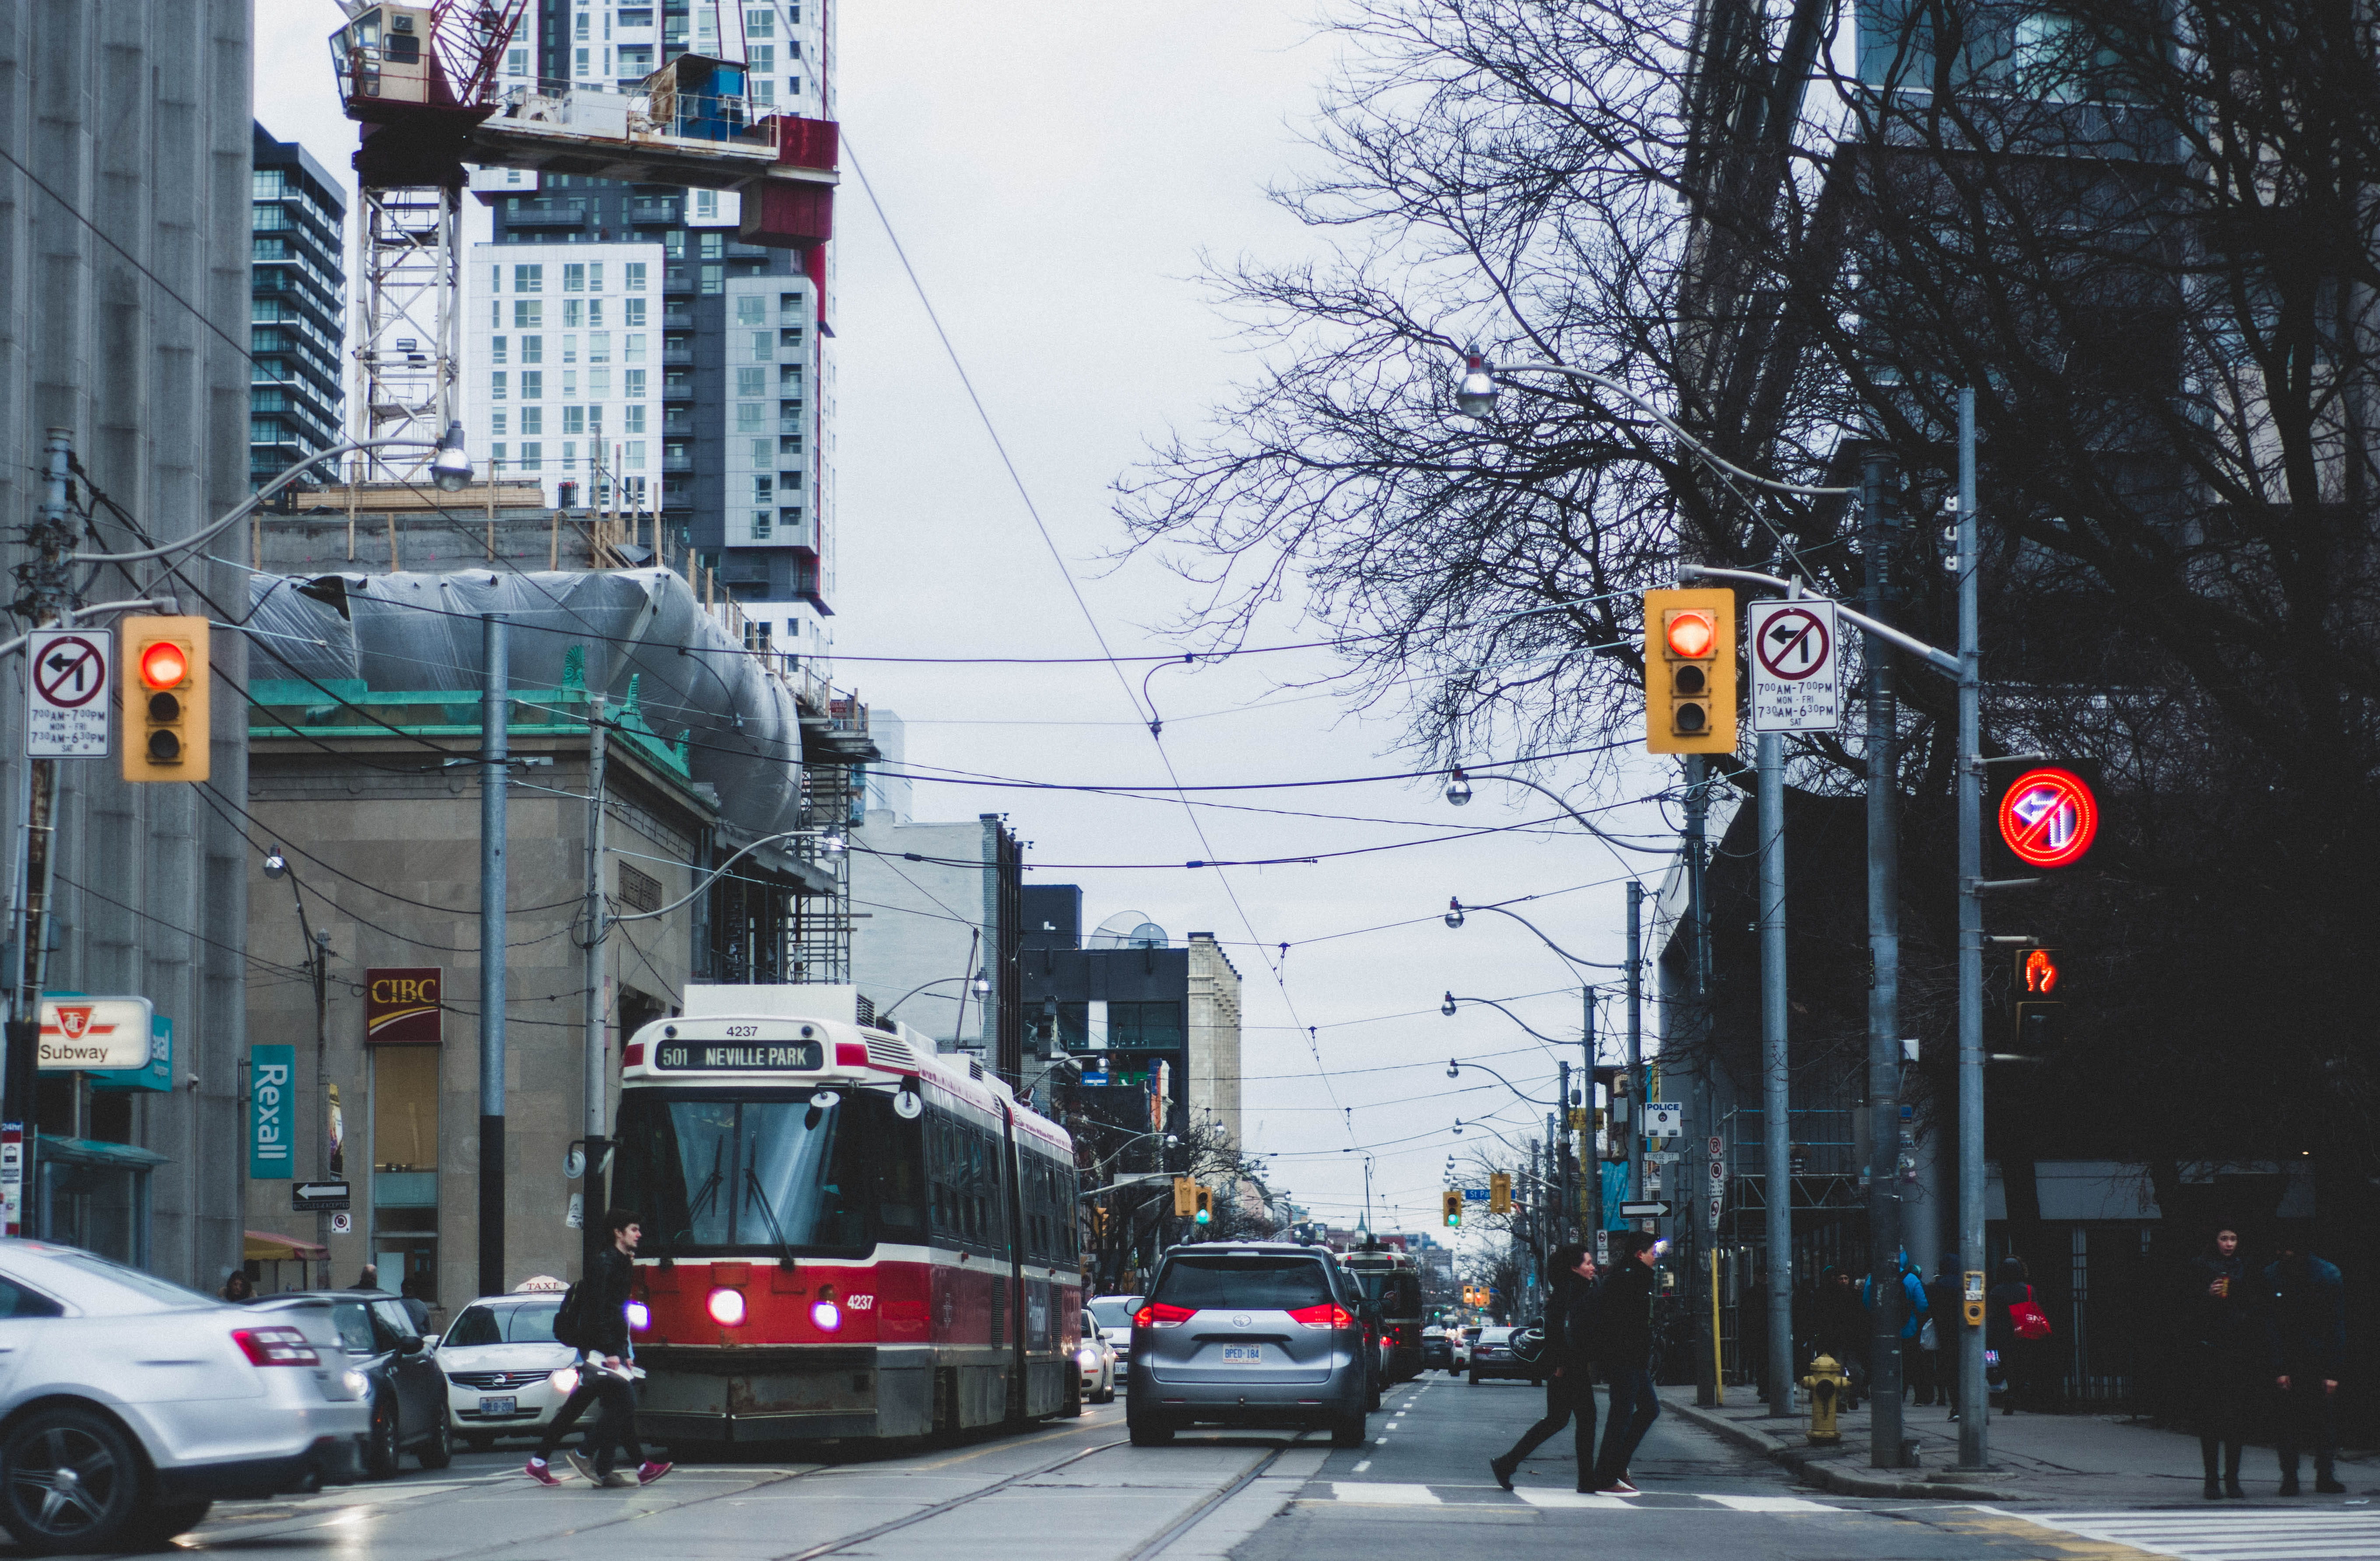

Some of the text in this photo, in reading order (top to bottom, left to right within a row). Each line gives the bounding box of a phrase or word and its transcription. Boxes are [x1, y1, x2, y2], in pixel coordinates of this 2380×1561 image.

[1790, 718, 1802, 726] SAT
[61, 744, 74, 752] SAT
[372, 979, 436, 1004] CIBC
[726, 1026, 758, 1037] 4237
[40, 1044, 109, 1062] Subway
[663, 1048, 807, 1066] 501 NEVILLE PARK
[254, 1064, 288, 1159] Rexall
[847, 1294, 874, 1310] 4237
